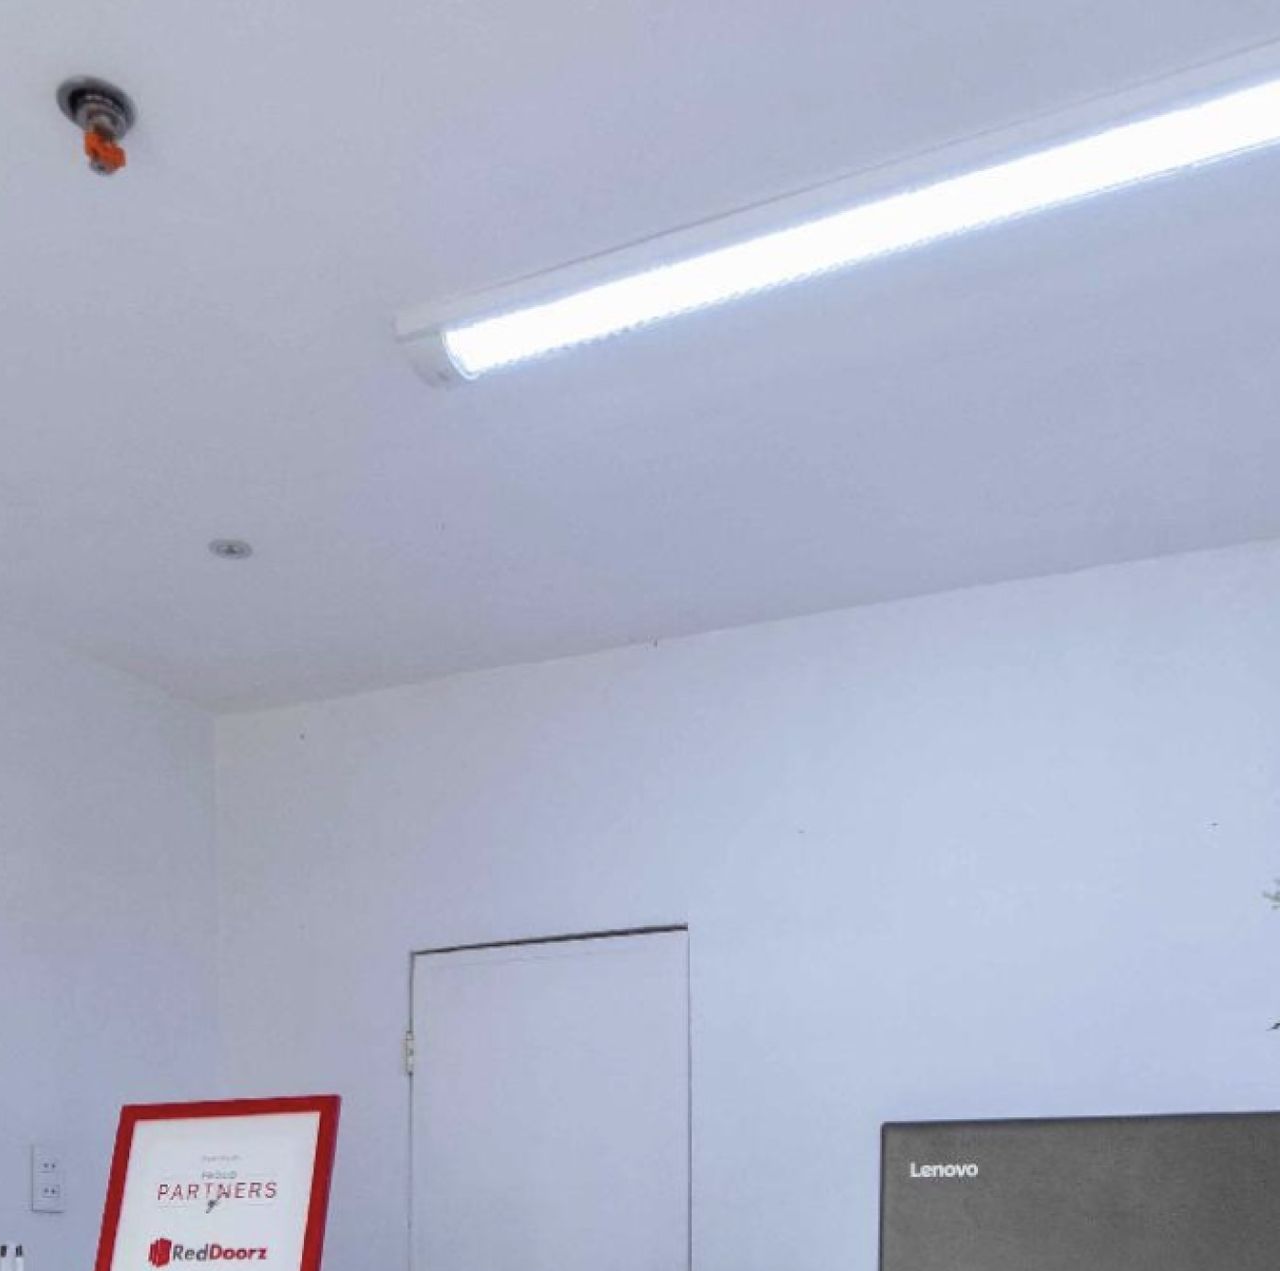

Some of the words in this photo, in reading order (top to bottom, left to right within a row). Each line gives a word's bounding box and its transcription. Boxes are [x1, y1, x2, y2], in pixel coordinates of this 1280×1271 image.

[909, 1161, 979, 1178] Lenovo
[157, 1181, 279, 1202] PARTNERS
[172, 1243, 268, 1262] RedDoorz
